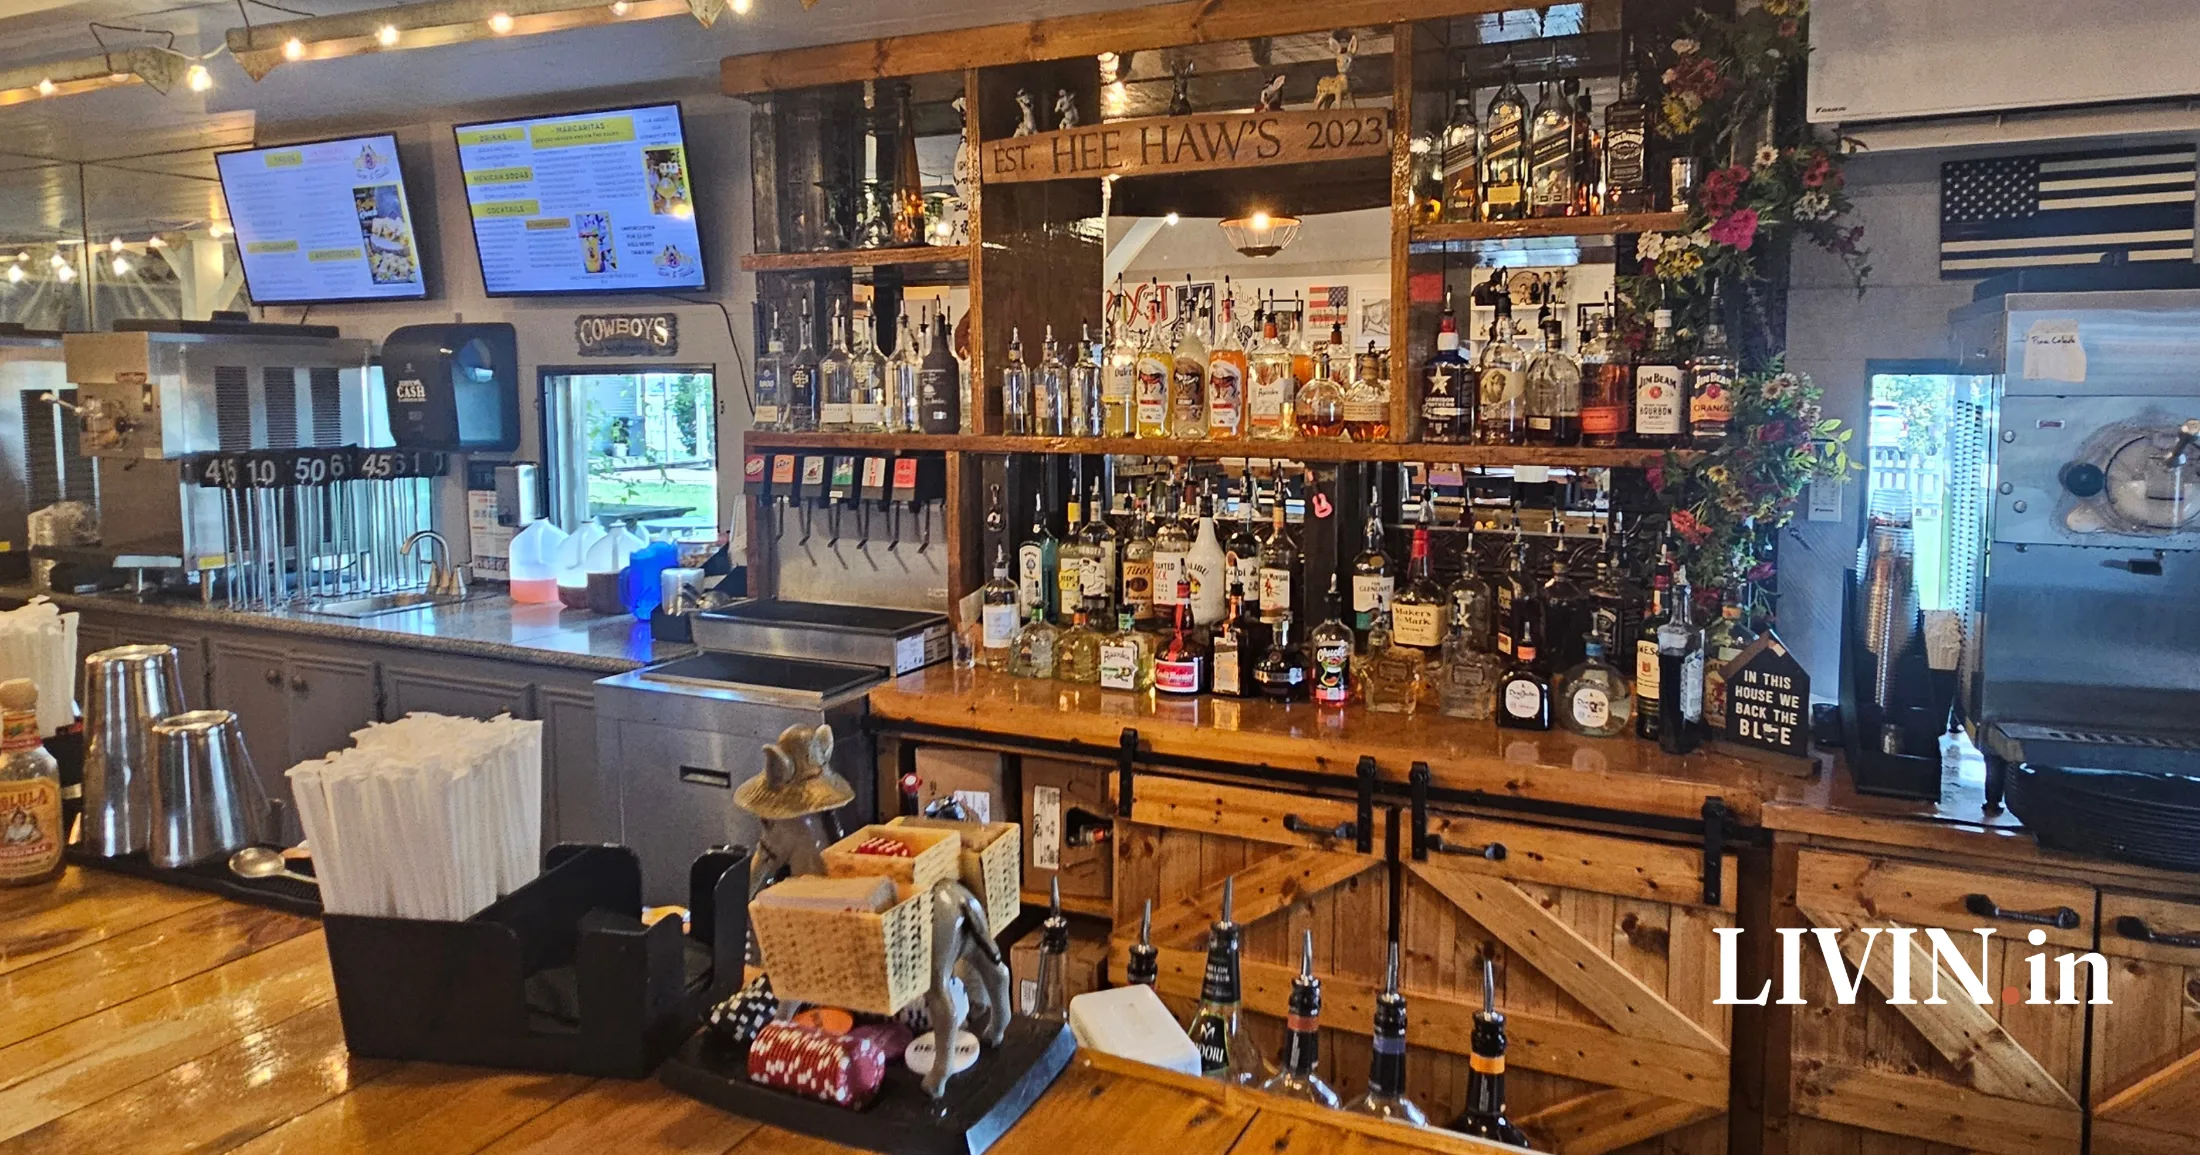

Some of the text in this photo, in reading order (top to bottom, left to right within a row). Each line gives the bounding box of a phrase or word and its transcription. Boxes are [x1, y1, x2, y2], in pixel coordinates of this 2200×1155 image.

[993, 116, 1383, 174] EST. HEE HAW'S 2023
[580, 316, 669, 347] COWBOYS
[1638, 372, 1677, 390] JIM BEAM
[396, 386, 426, 399] CASH
[1639, 406, 1672, 416] BOURBON
[246, 459, 276, 486] 10
[294, 457, 327, 485] 50
[361, 453, 393, 477] 45
[1126, 565, 1153, 576] Tito's
[1395, 607, 1432, 617] Maker's
[1404, 617, 1431, 626] Mark
[1743, 669, 1792, 689] IN THIS
[1735, 685, 1800, 709] HOUSE WE
[1735, 703, 1798, 726] BACK THE
